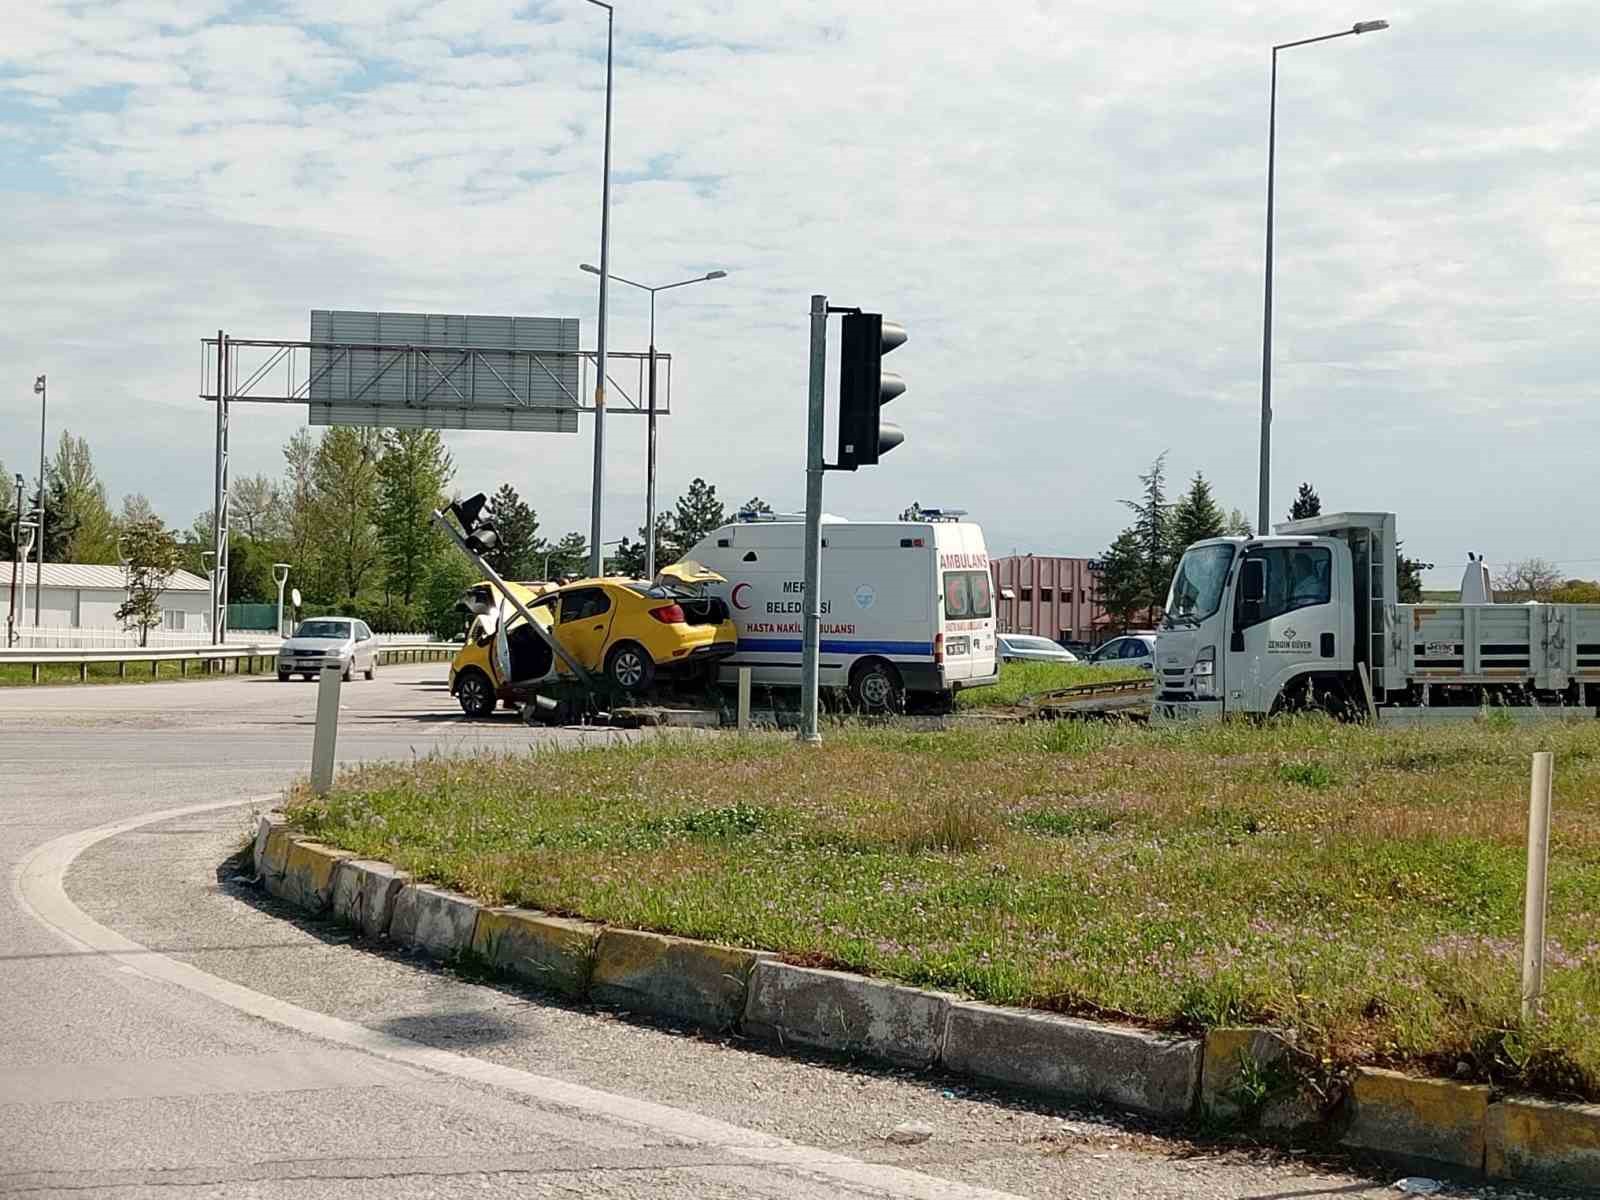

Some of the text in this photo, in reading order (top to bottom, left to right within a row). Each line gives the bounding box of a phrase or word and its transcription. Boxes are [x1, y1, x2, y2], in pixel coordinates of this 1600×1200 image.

[940, 553, 988, 569] AMBULANS
[766, 599, 832, 614] BELEDİSİ
[746, 623, 775, 634] HASTA
